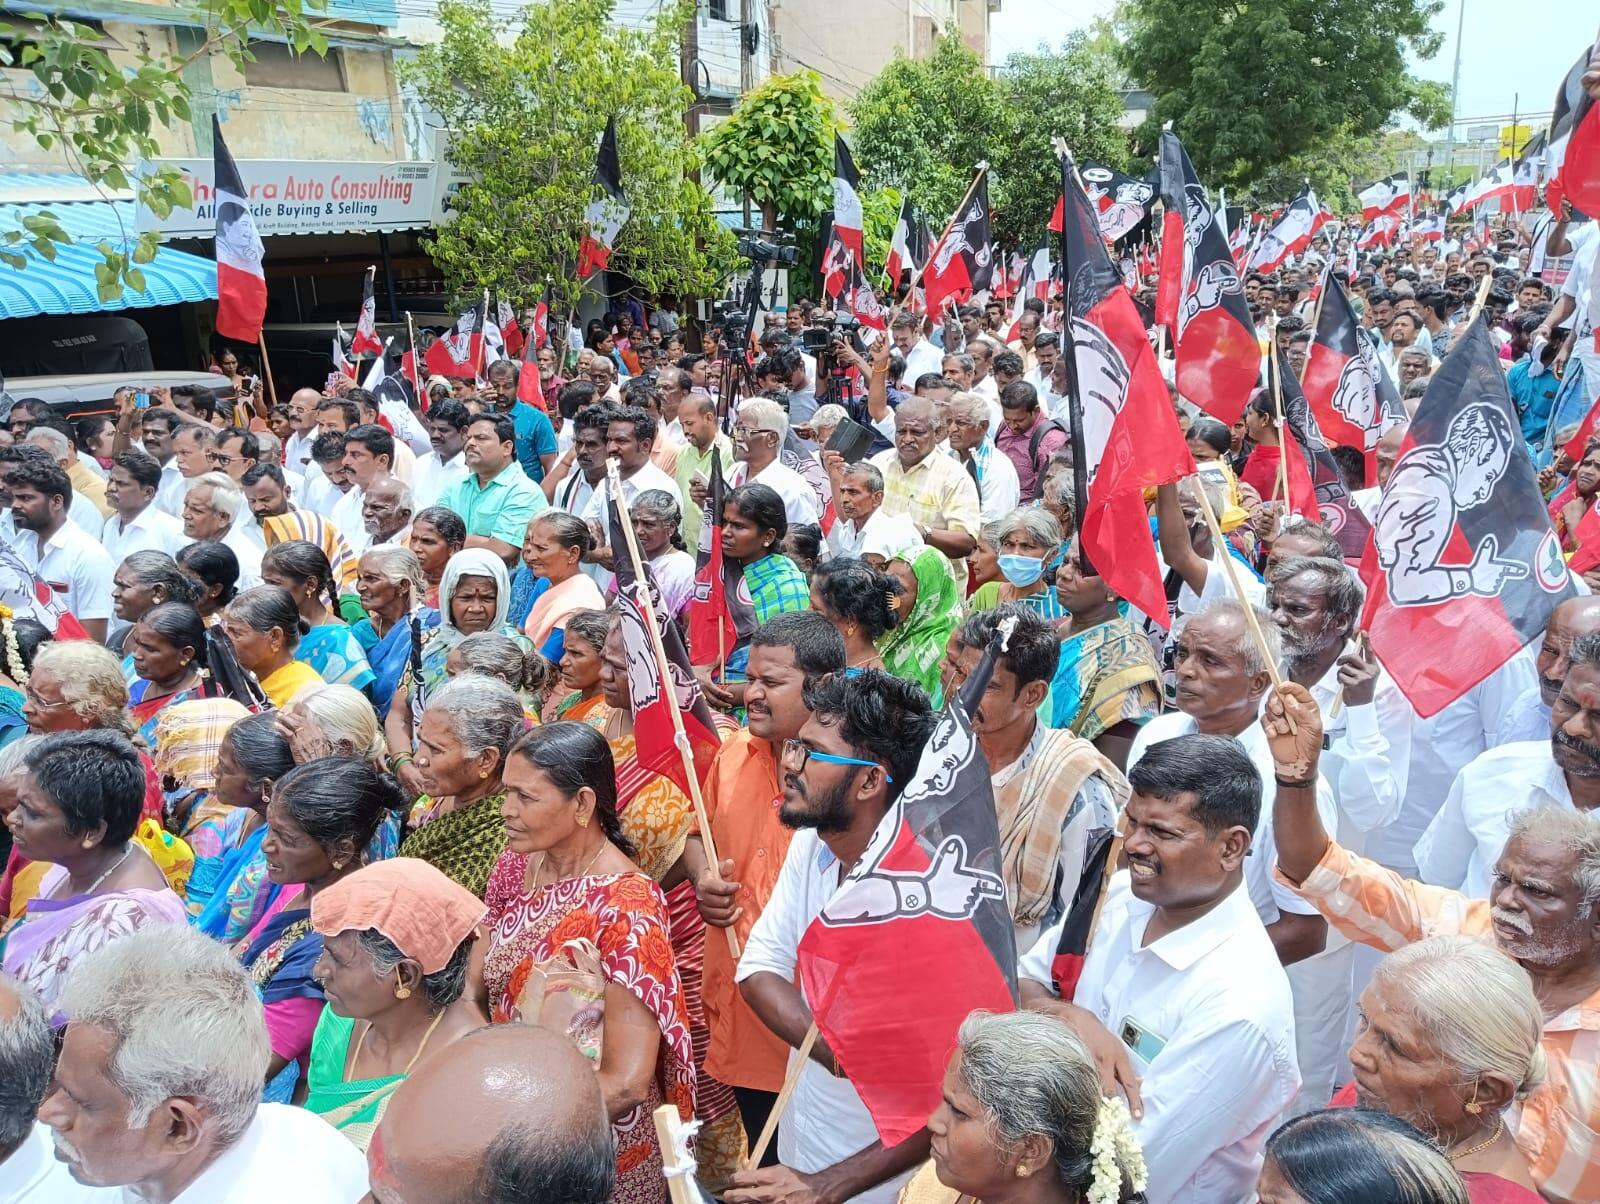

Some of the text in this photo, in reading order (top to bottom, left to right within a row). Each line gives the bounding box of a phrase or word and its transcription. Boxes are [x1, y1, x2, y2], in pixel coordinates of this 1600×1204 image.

[283, 175, 324, 201] Auto
[331, 174, 413, 205] Consulting
[197, 205, 216, 219] All
[277, 202, 321, 219] Buying
[325, 202, 333, 215] &
[338, 201, 378, 216] Selling
